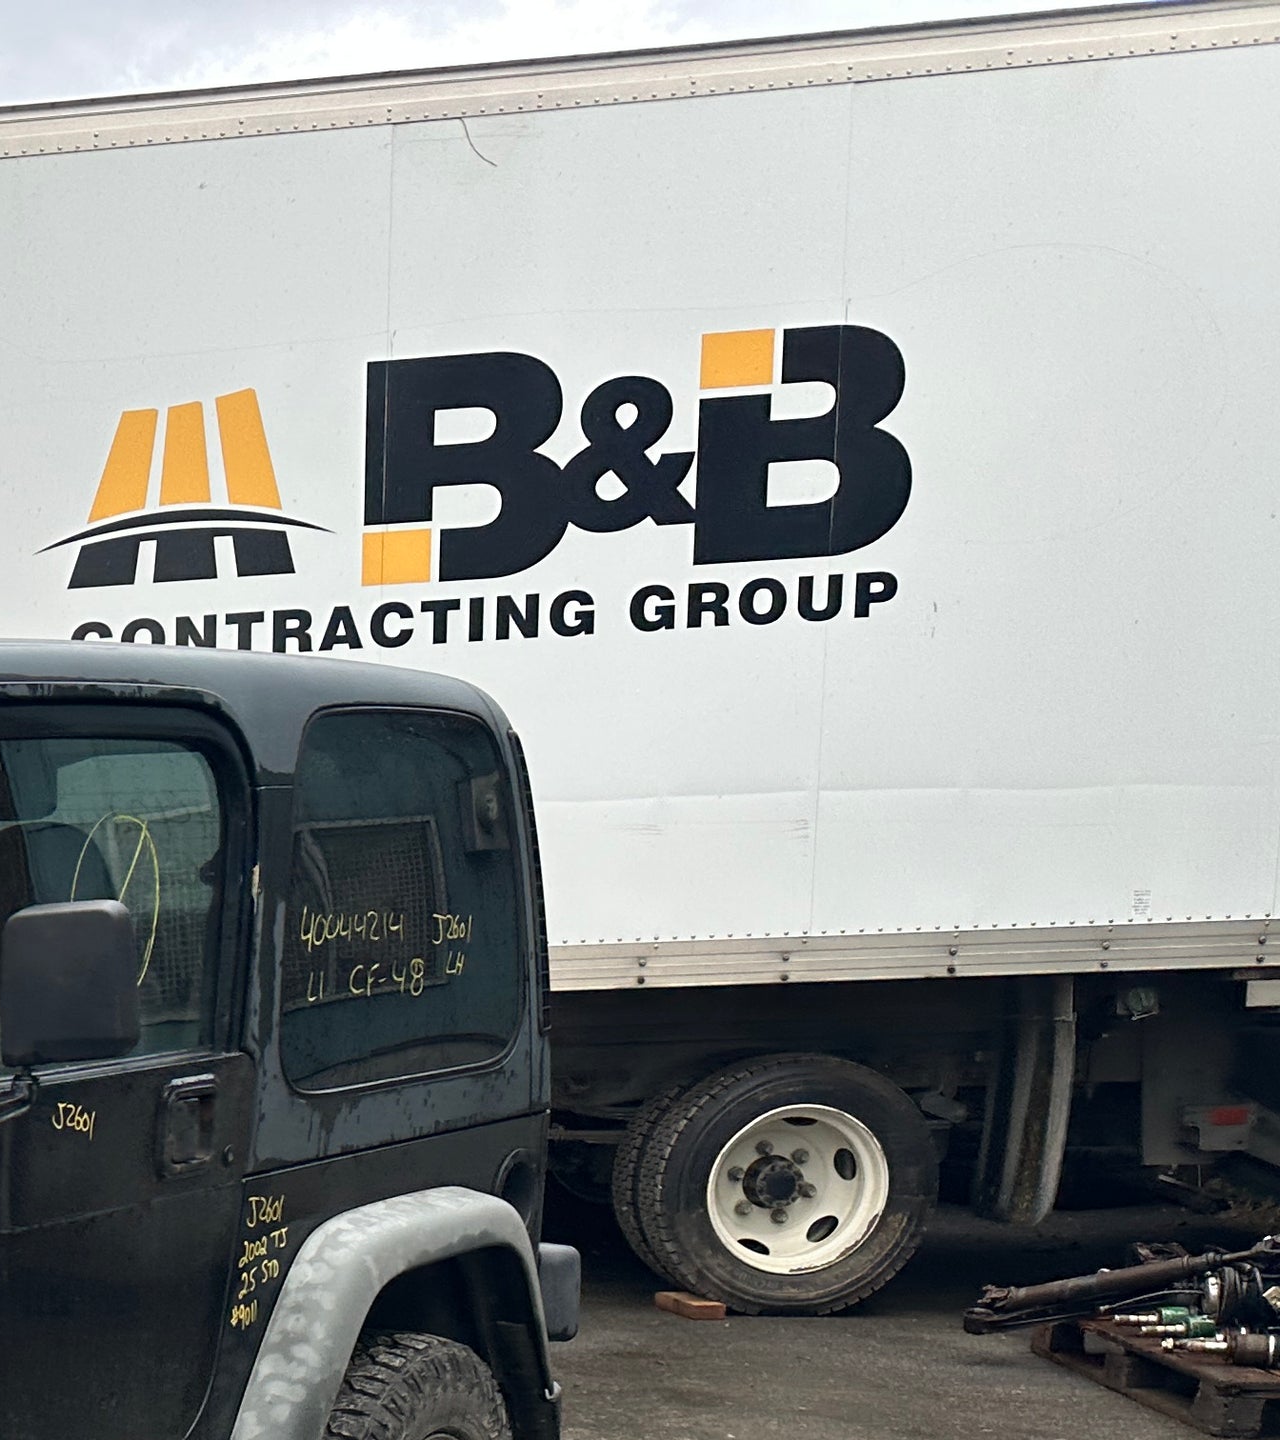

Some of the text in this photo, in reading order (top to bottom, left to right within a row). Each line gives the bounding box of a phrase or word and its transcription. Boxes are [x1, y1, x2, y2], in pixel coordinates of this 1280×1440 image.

[361, 324, 913, 586] B&B
[629, 571, 898, 632] GROUP
[432, 914, 472, 944] J2601
[445, 950, 465, 976] LH
[52, 1102, 96, 1140] J2601
[246, 1195, 285, 1228] J2601
[238, 1227, 289, 1268] 2002 TJ
[261, 1259, 280, 1283] STD
